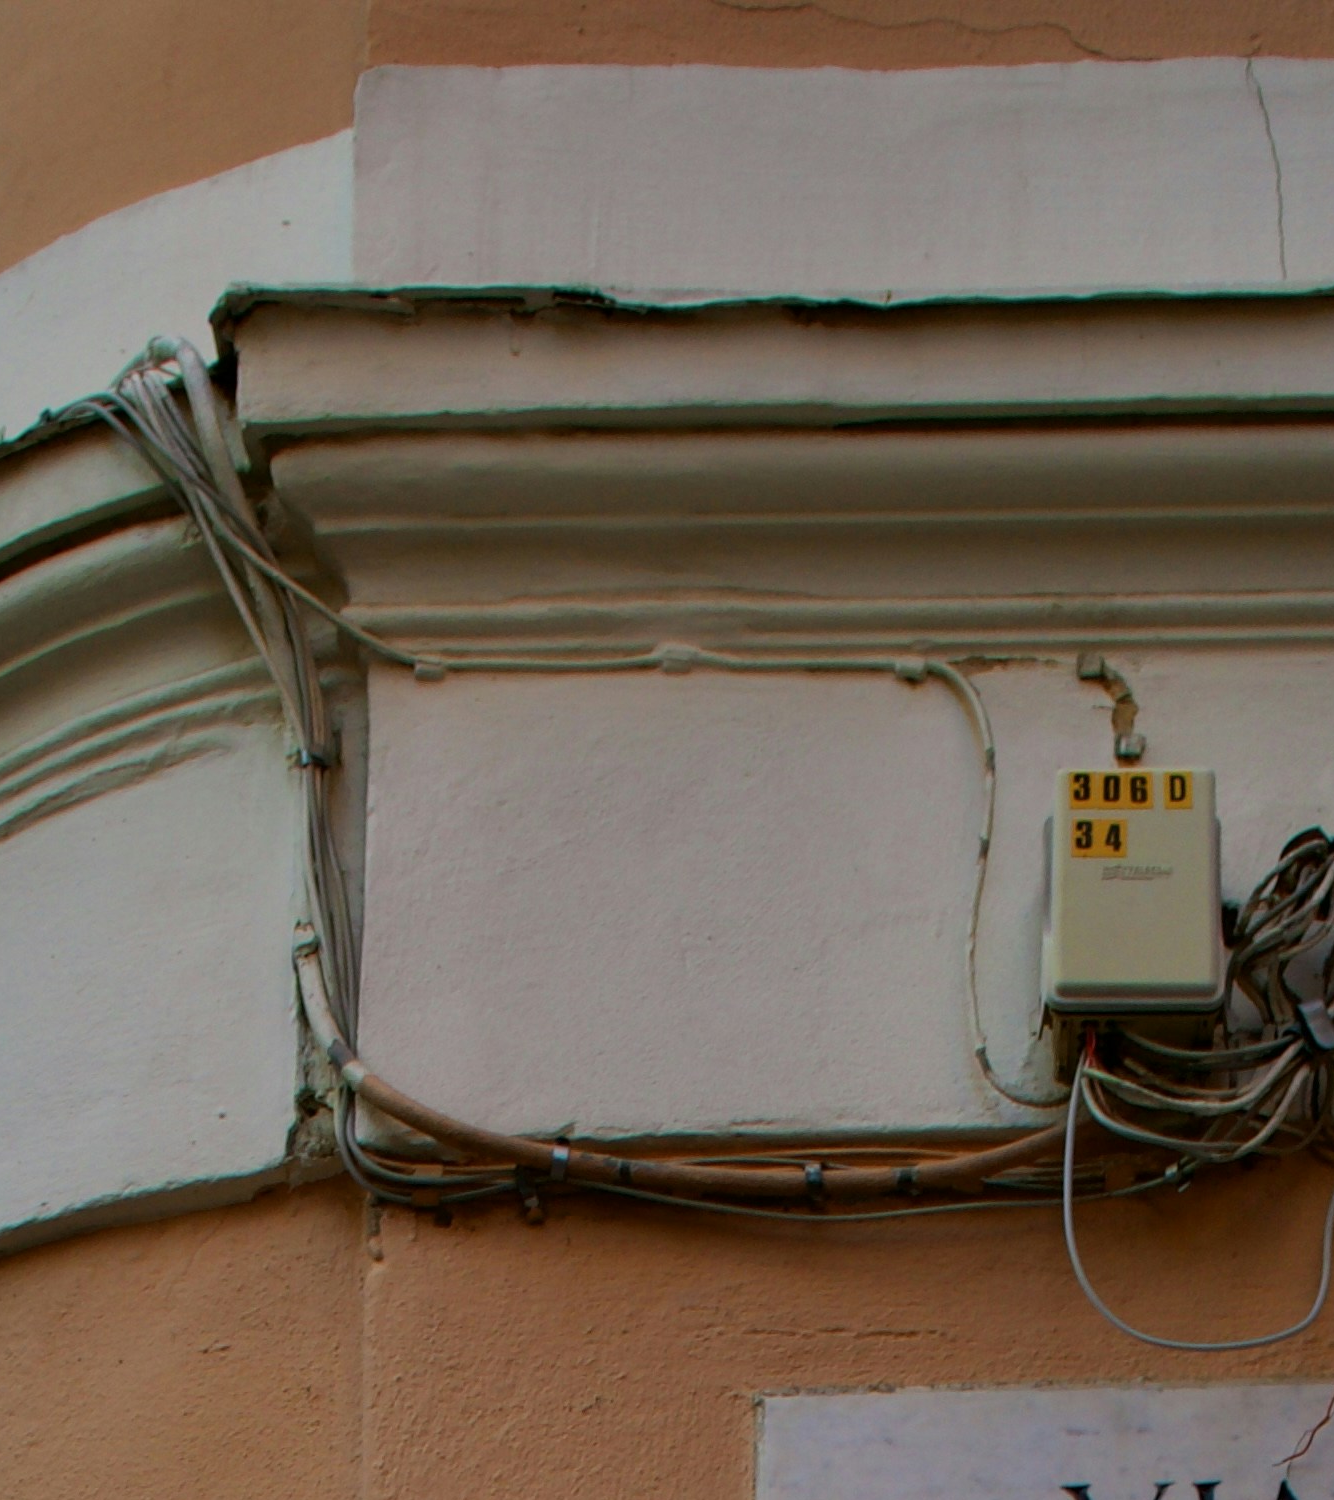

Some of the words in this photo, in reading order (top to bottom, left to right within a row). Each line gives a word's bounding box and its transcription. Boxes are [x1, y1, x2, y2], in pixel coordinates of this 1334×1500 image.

[1073, 773, 1148, 804] 306
[1169, 774, 1187, 802] D
[1075, 820, 1122, 852] 34
